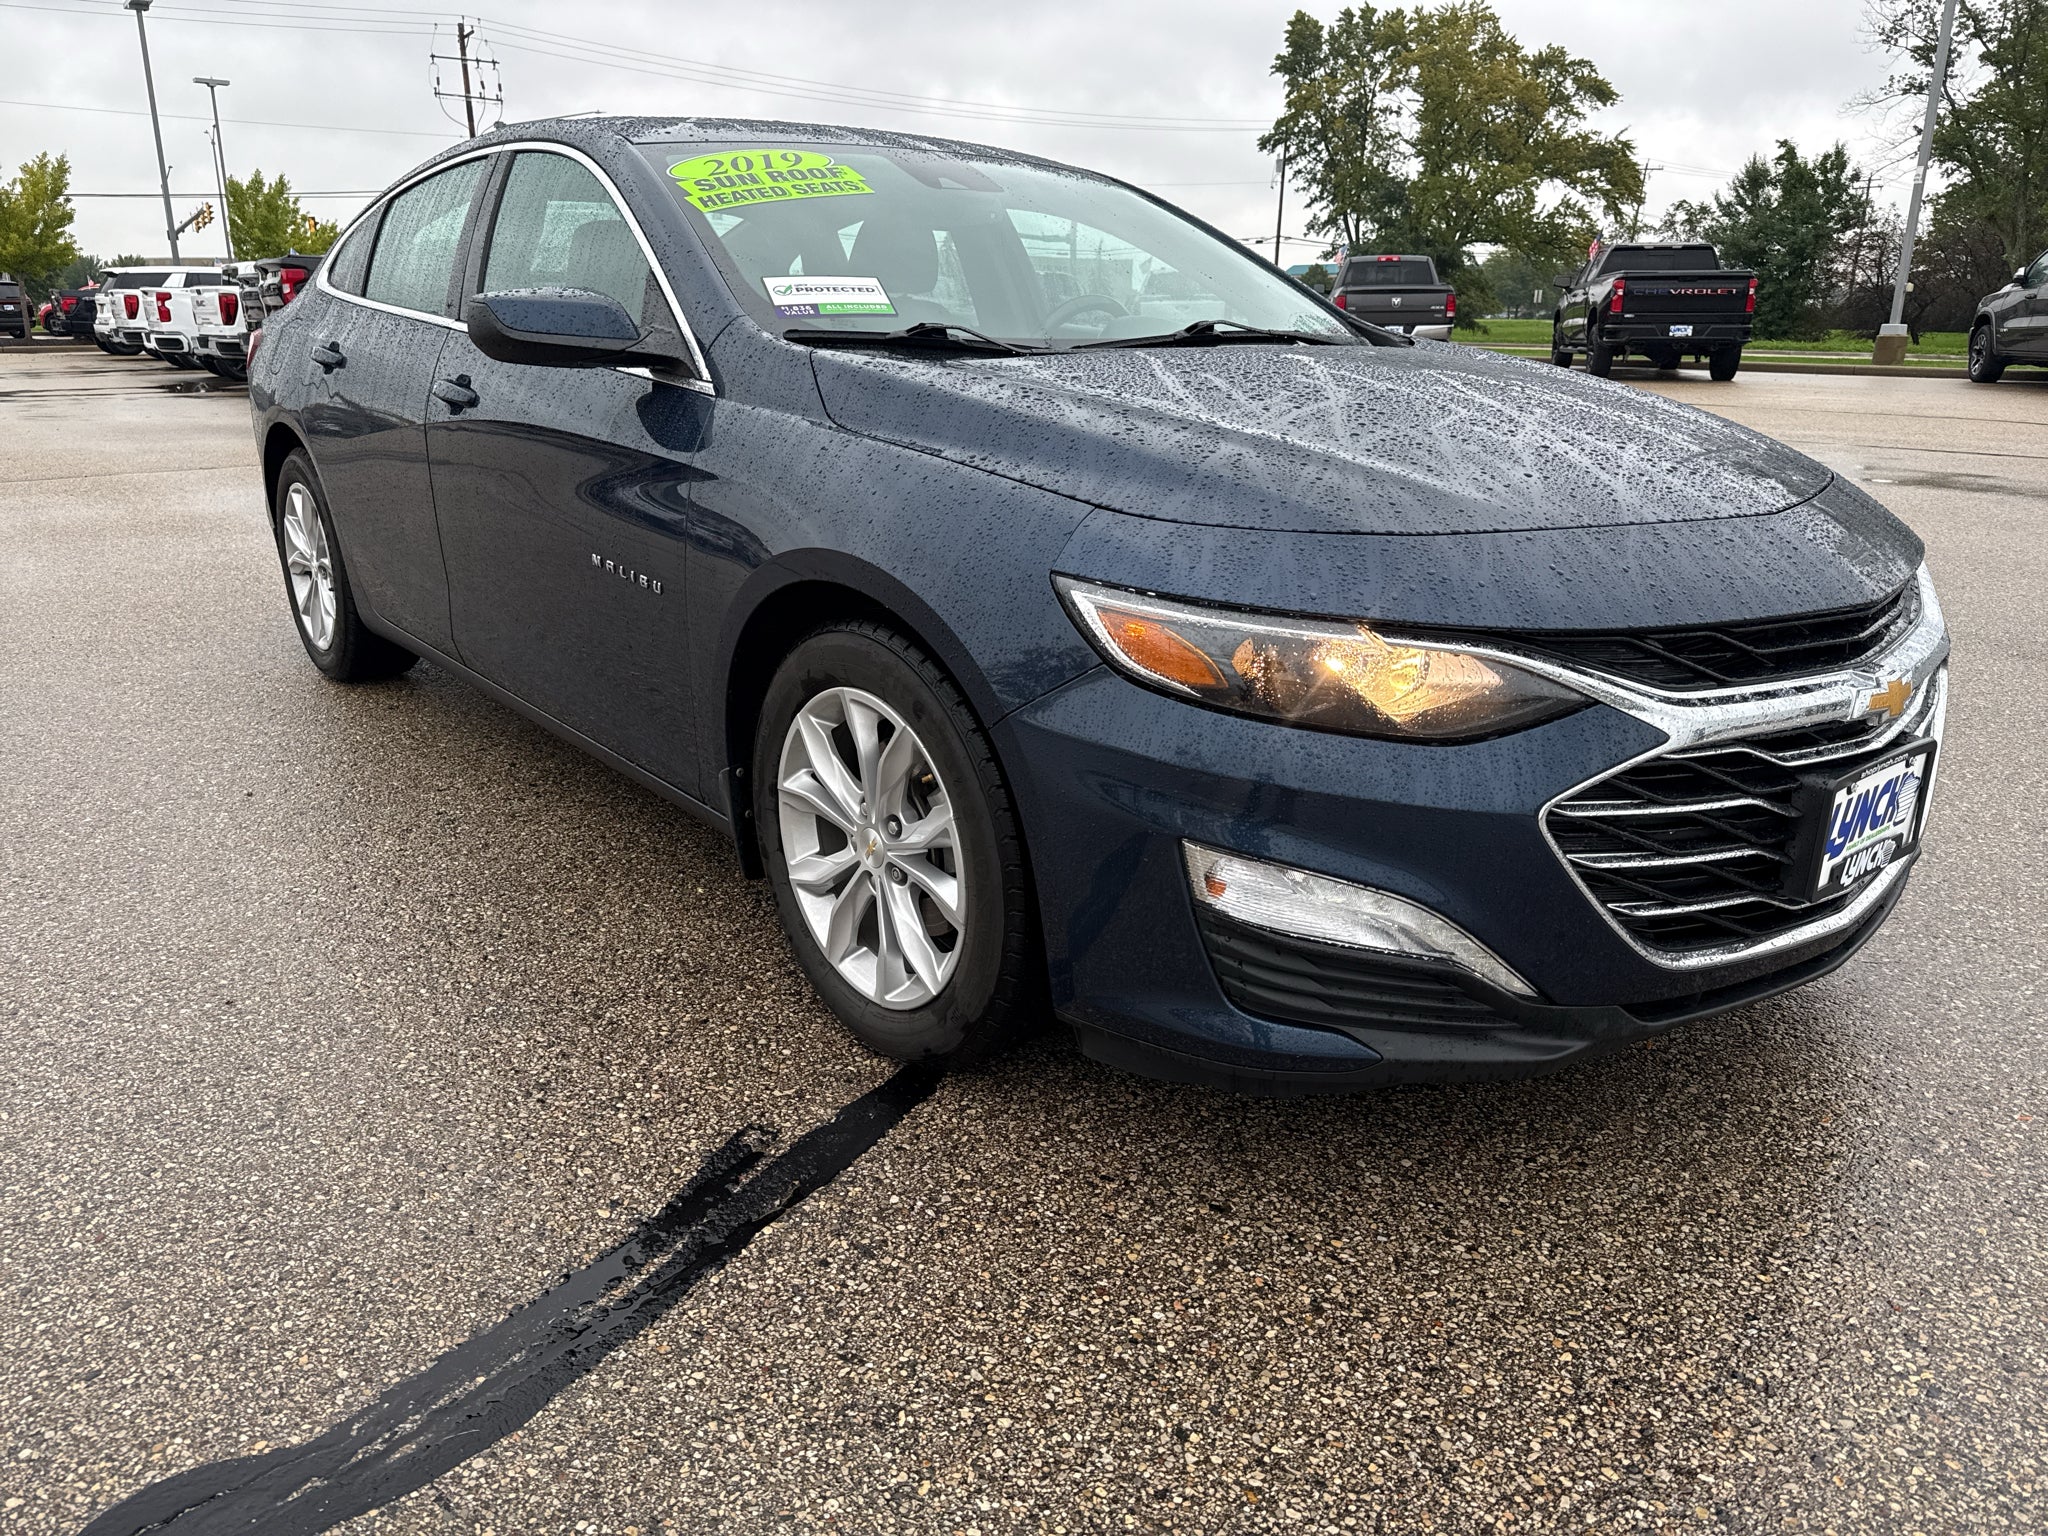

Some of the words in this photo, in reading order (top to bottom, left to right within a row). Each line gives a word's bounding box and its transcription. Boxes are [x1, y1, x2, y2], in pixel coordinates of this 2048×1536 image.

[693, 172, 760, 192] SUN
[766, 166, 847, 183] ROOF
[703, 152, 803, 177] 2019
[697, 183, 790, 208] HEATED
[790, 180, 861, 195] SEATS
[591, 553, 663, 596] MALIBU
[1824, 771, 1909, 862] LYNCH
[1840, 839, 1889, 887] LYNCH
